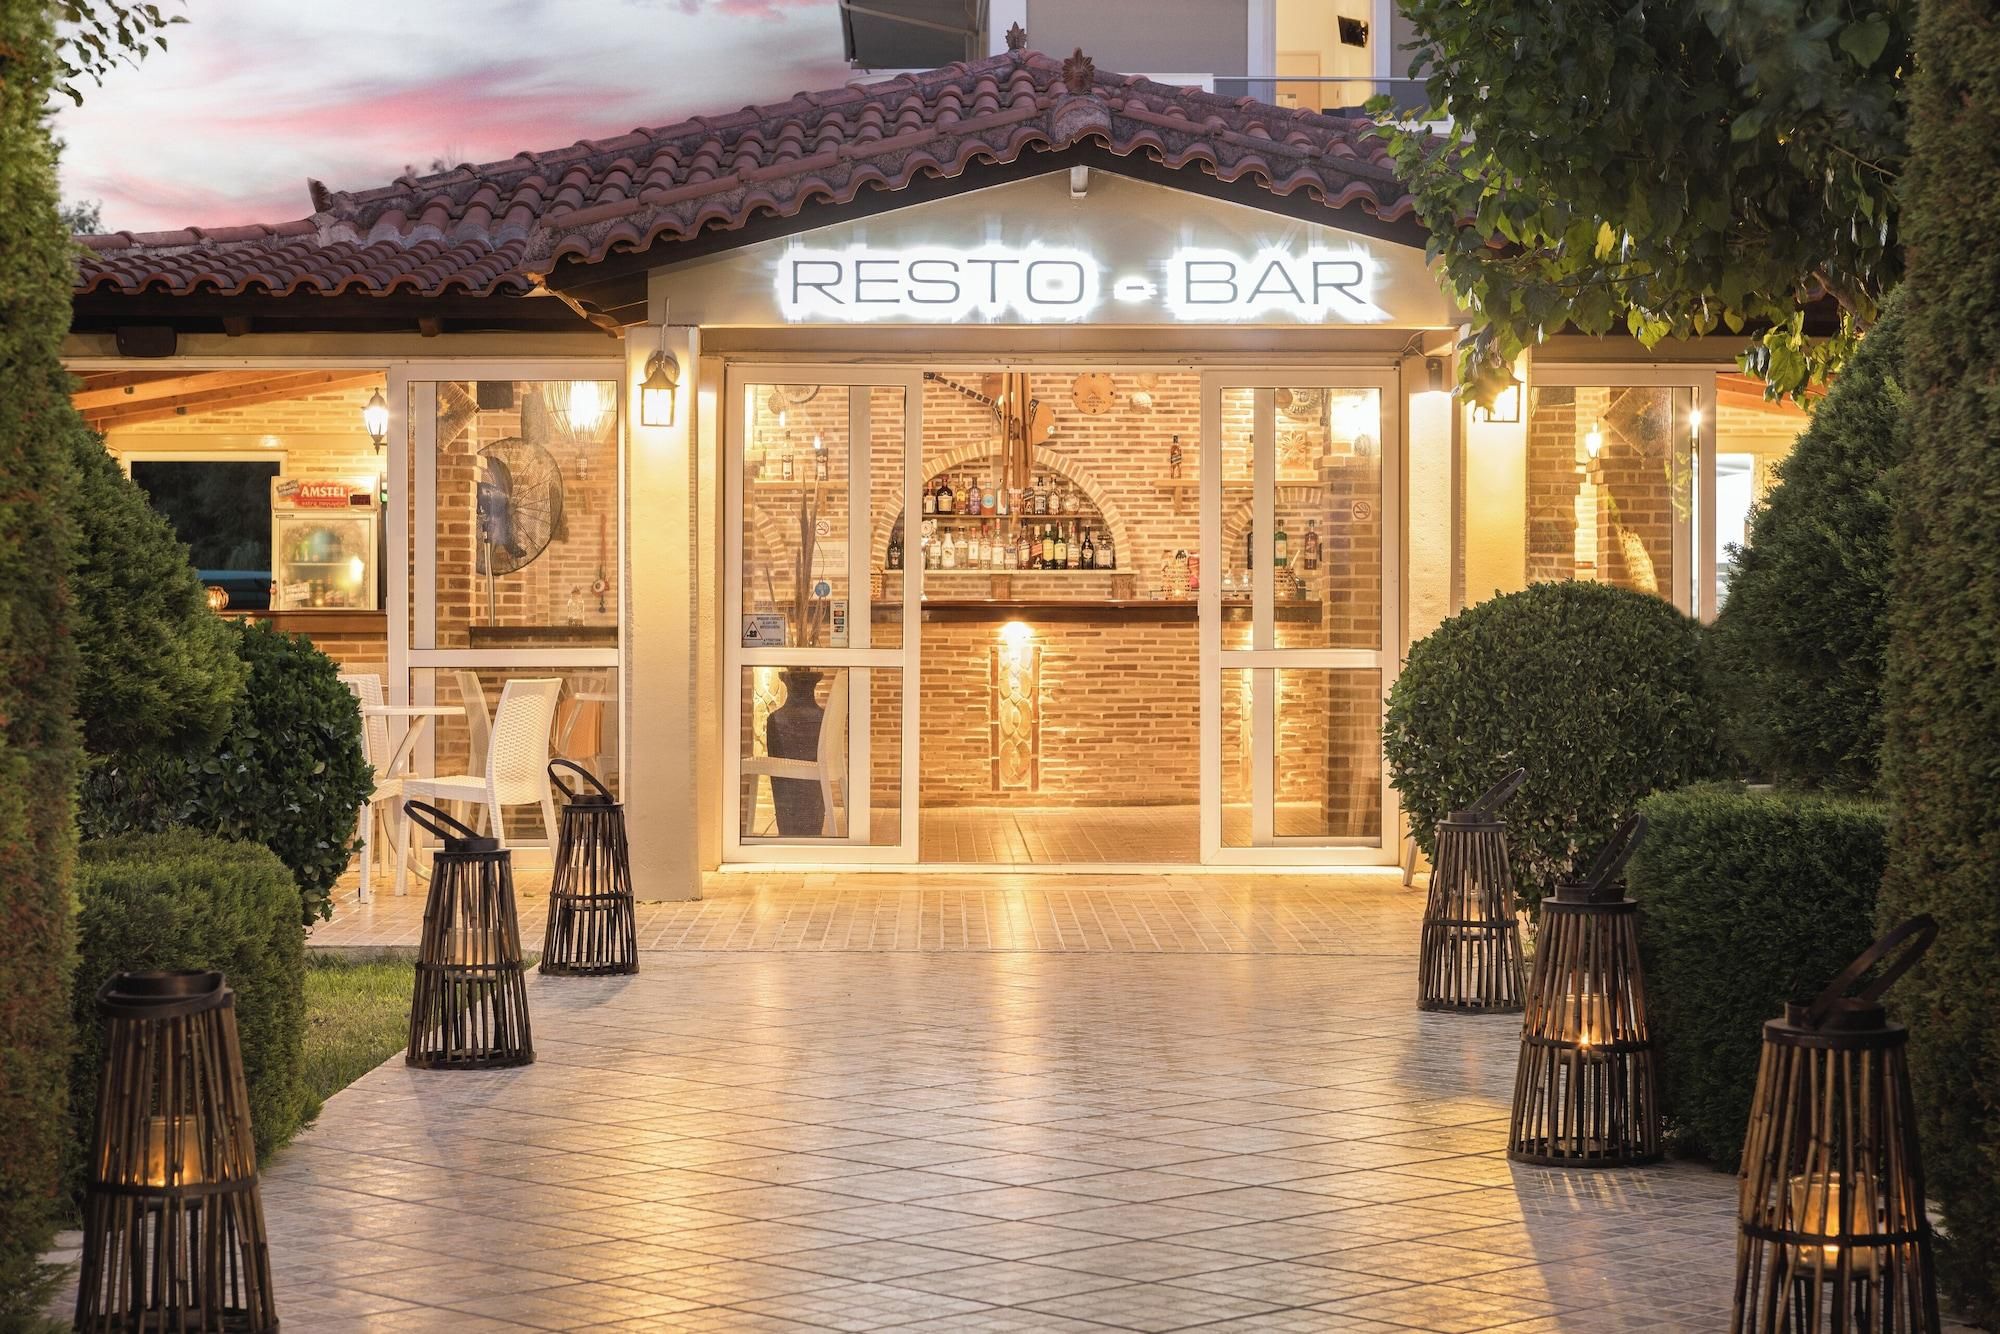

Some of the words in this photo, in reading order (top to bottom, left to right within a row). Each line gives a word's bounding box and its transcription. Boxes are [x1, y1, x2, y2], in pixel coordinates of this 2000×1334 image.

[792, 259, 1086, 305] RESTO
[1185, 260, 1367, 304] BAR
[301, 485, 346, 497] AMSTEL
